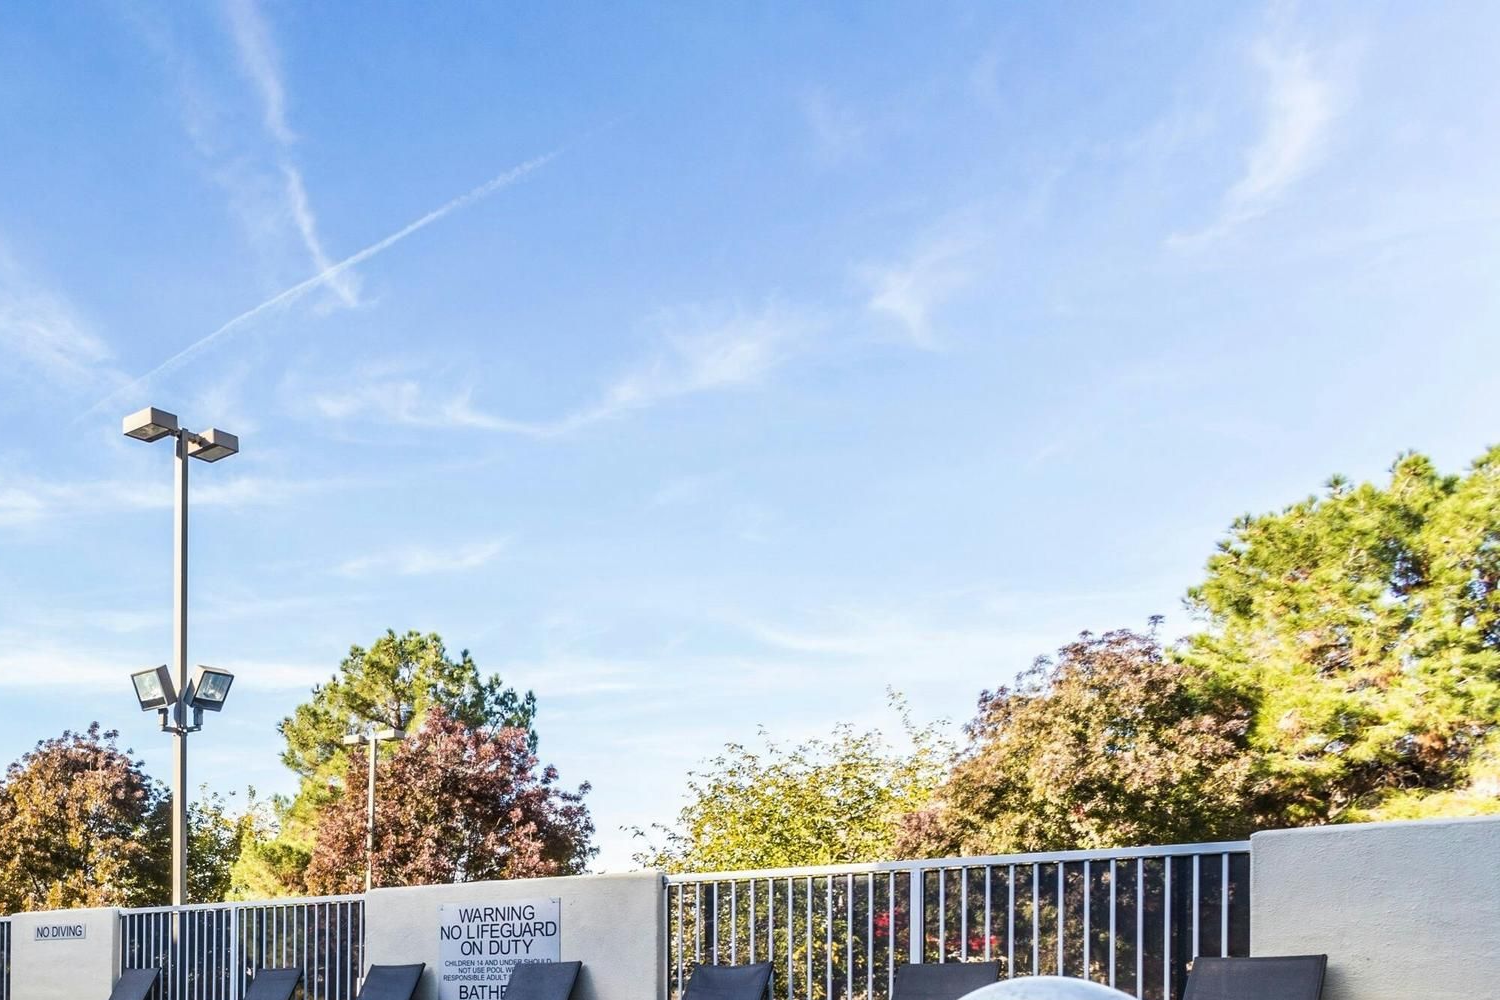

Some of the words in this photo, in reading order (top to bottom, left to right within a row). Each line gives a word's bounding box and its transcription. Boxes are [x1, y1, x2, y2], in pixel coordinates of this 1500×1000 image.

[459, 905, 535, 923] WARNING
[36, 926, 50, 938] NO
[52, 925, 83, 938] DIVING
[441, 925, 462, 940] NO
[467, 921, 557, 939] LIFEGUARD
[460, 940, 483, 955] ON
[489, 939, 534, 955] DUTY
[459, 985, 508, 1000] BATHE
